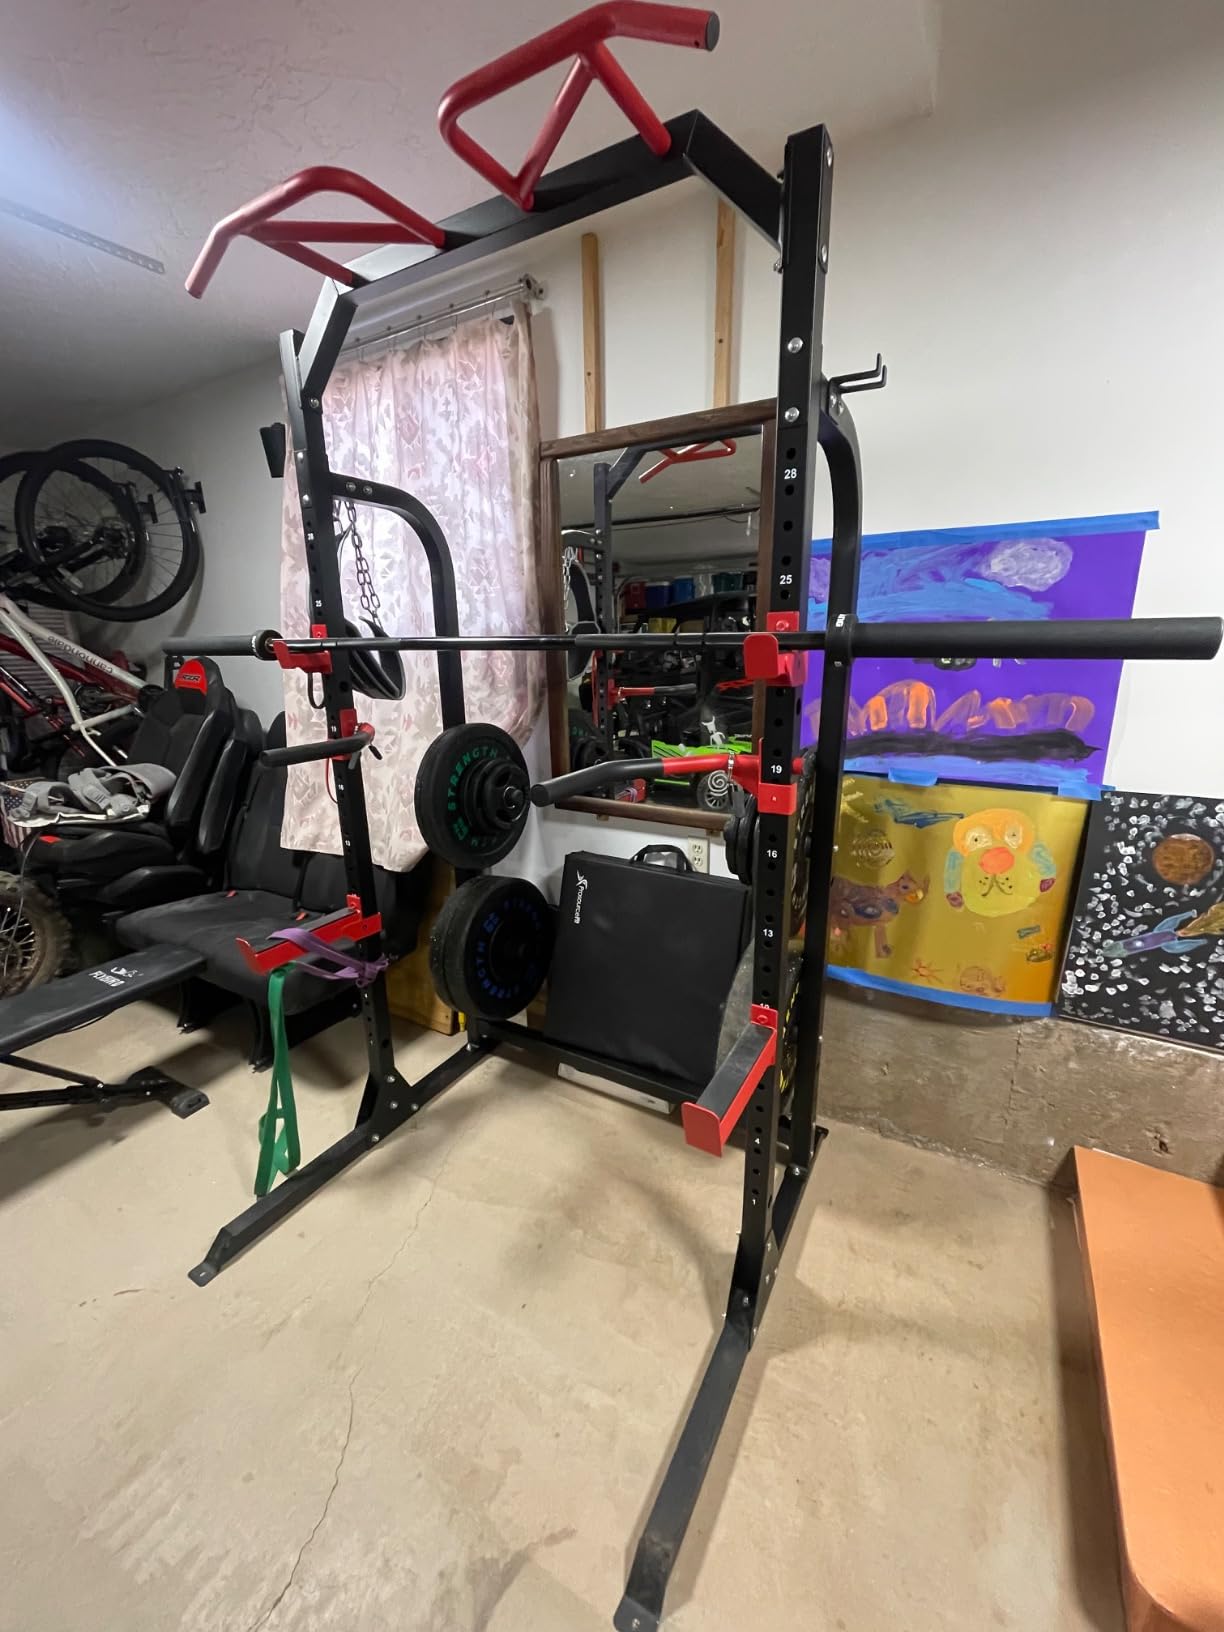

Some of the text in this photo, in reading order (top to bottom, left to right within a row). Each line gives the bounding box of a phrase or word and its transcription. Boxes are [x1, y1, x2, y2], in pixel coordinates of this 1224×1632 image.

[784, 468, 797, 480] 28
[779, 575, 792, 585] 25
[47, 635, 113, 674] cannondale
[770, 765, 783, 774] 19
[447, 745, 499, 811] STRENGTH
[766, 849, 777, 858] 16
[762, 928, 774, 938] 13
[754, 1137, 760, 1145] 4
[752, 1198, 756, 1206] 1
